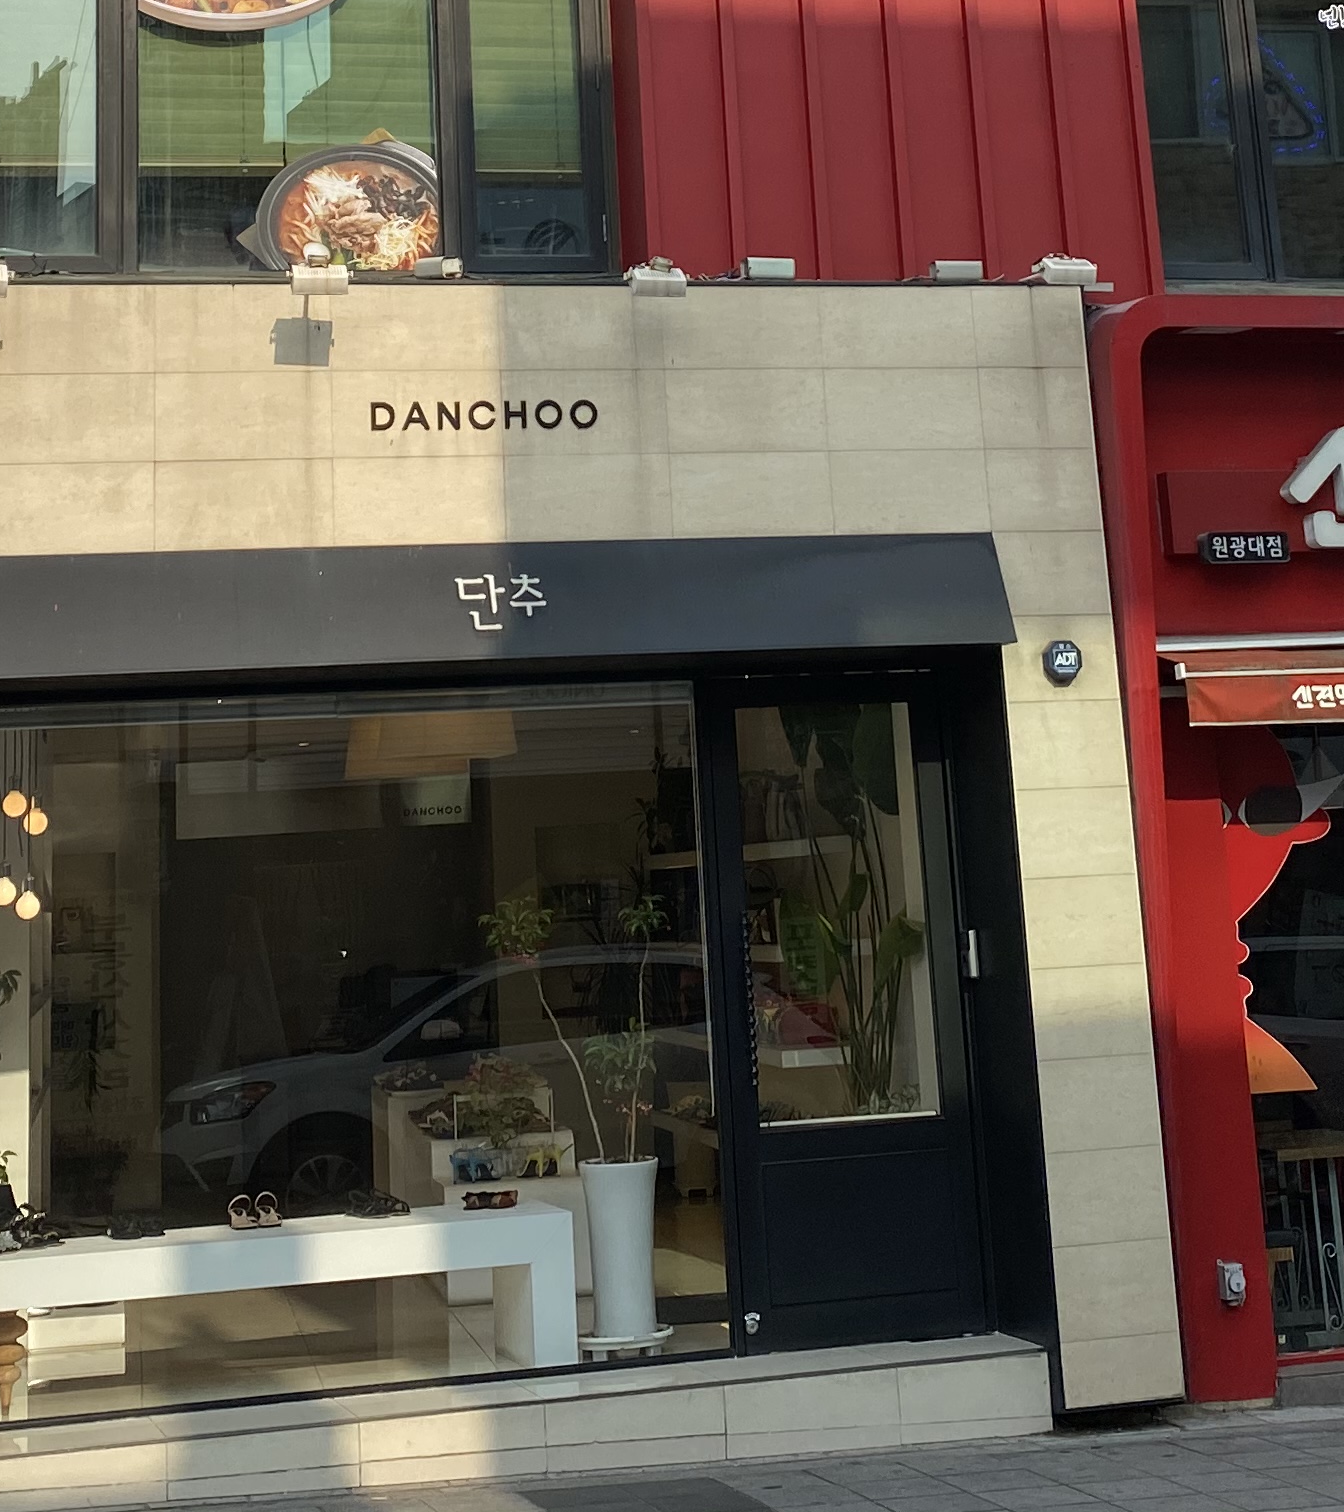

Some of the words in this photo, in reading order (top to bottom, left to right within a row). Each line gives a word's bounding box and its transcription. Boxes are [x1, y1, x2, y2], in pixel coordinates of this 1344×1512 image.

[368, 398, 600, 433] DANCHOO
[1211, 535, 1284, 559] 원광대점
[455, 573, 548, 632] 단추
[1055, 652, 1077, 666] ADT
[403, 805, 463, 817] DANCHOO
